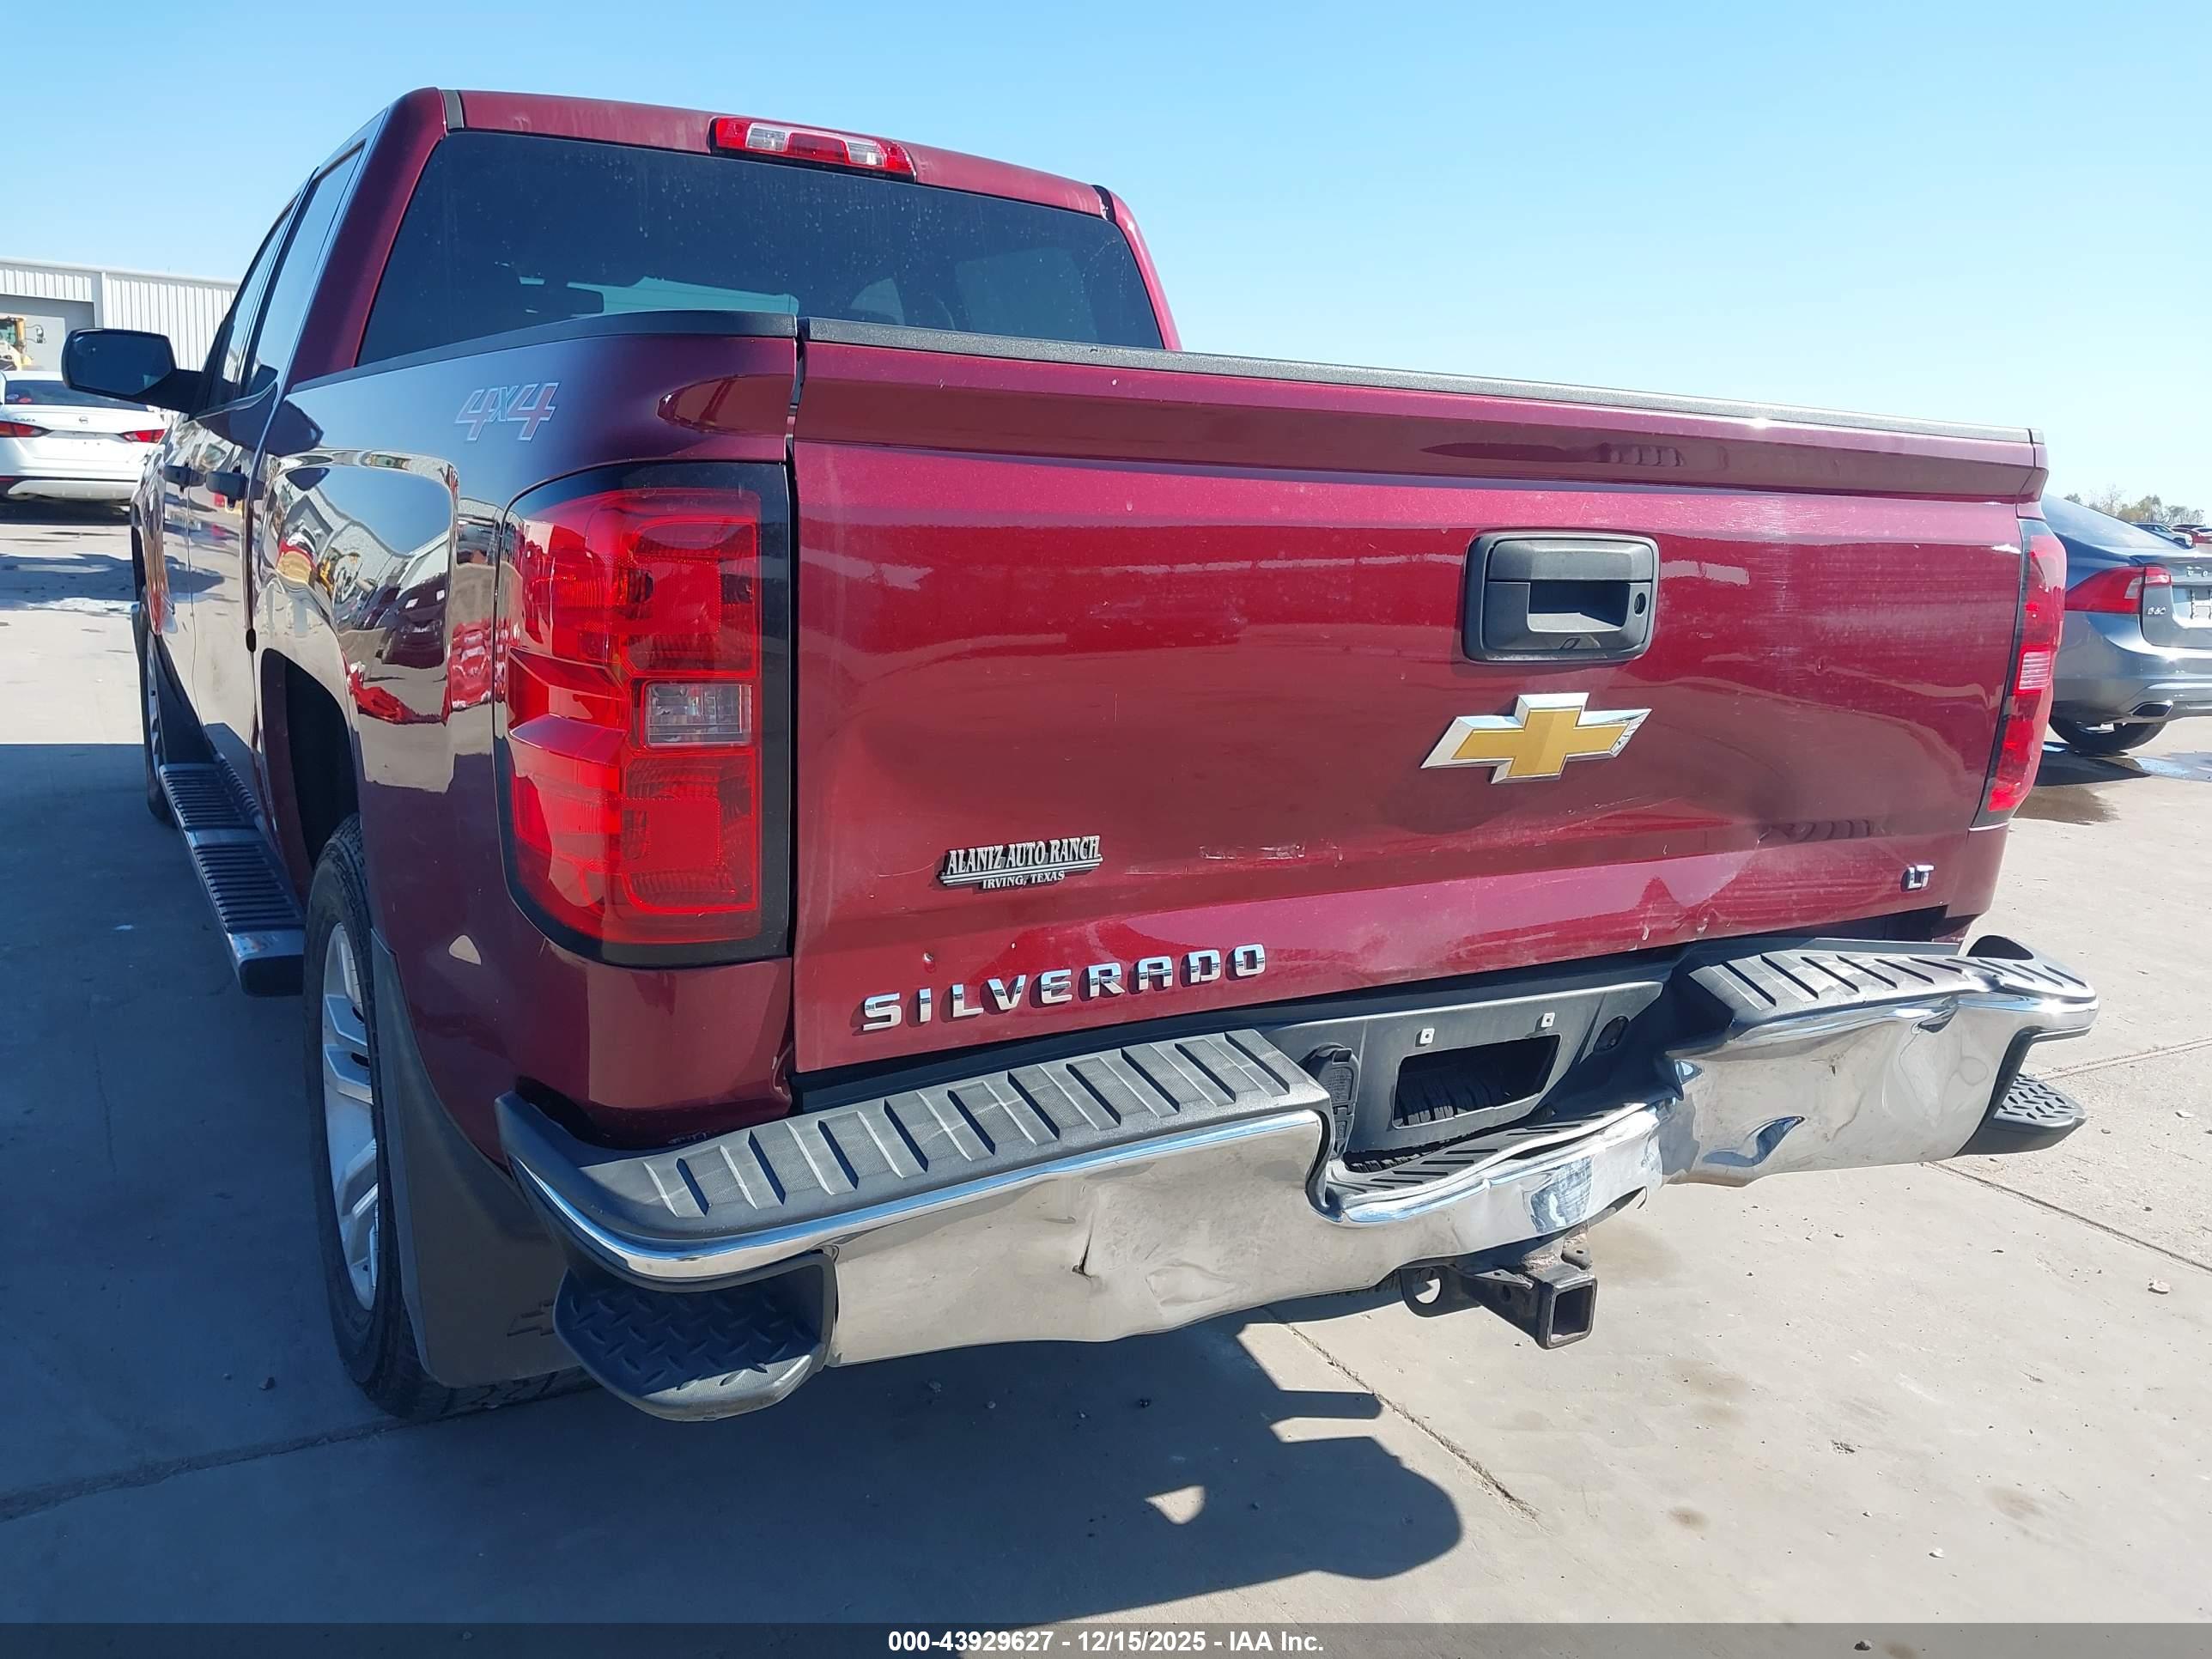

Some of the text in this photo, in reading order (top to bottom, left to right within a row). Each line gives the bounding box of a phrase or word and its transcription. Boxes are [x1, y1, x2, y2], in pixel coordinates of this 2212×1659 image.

[946, 835, 1102, 875] ALANIZ AUTO RANCH
[1030, 871, 1066, 884] TEXAS
[1907, 864, 1935, 890] LT
[861, 943, 1267, 1031] SILVERADO
